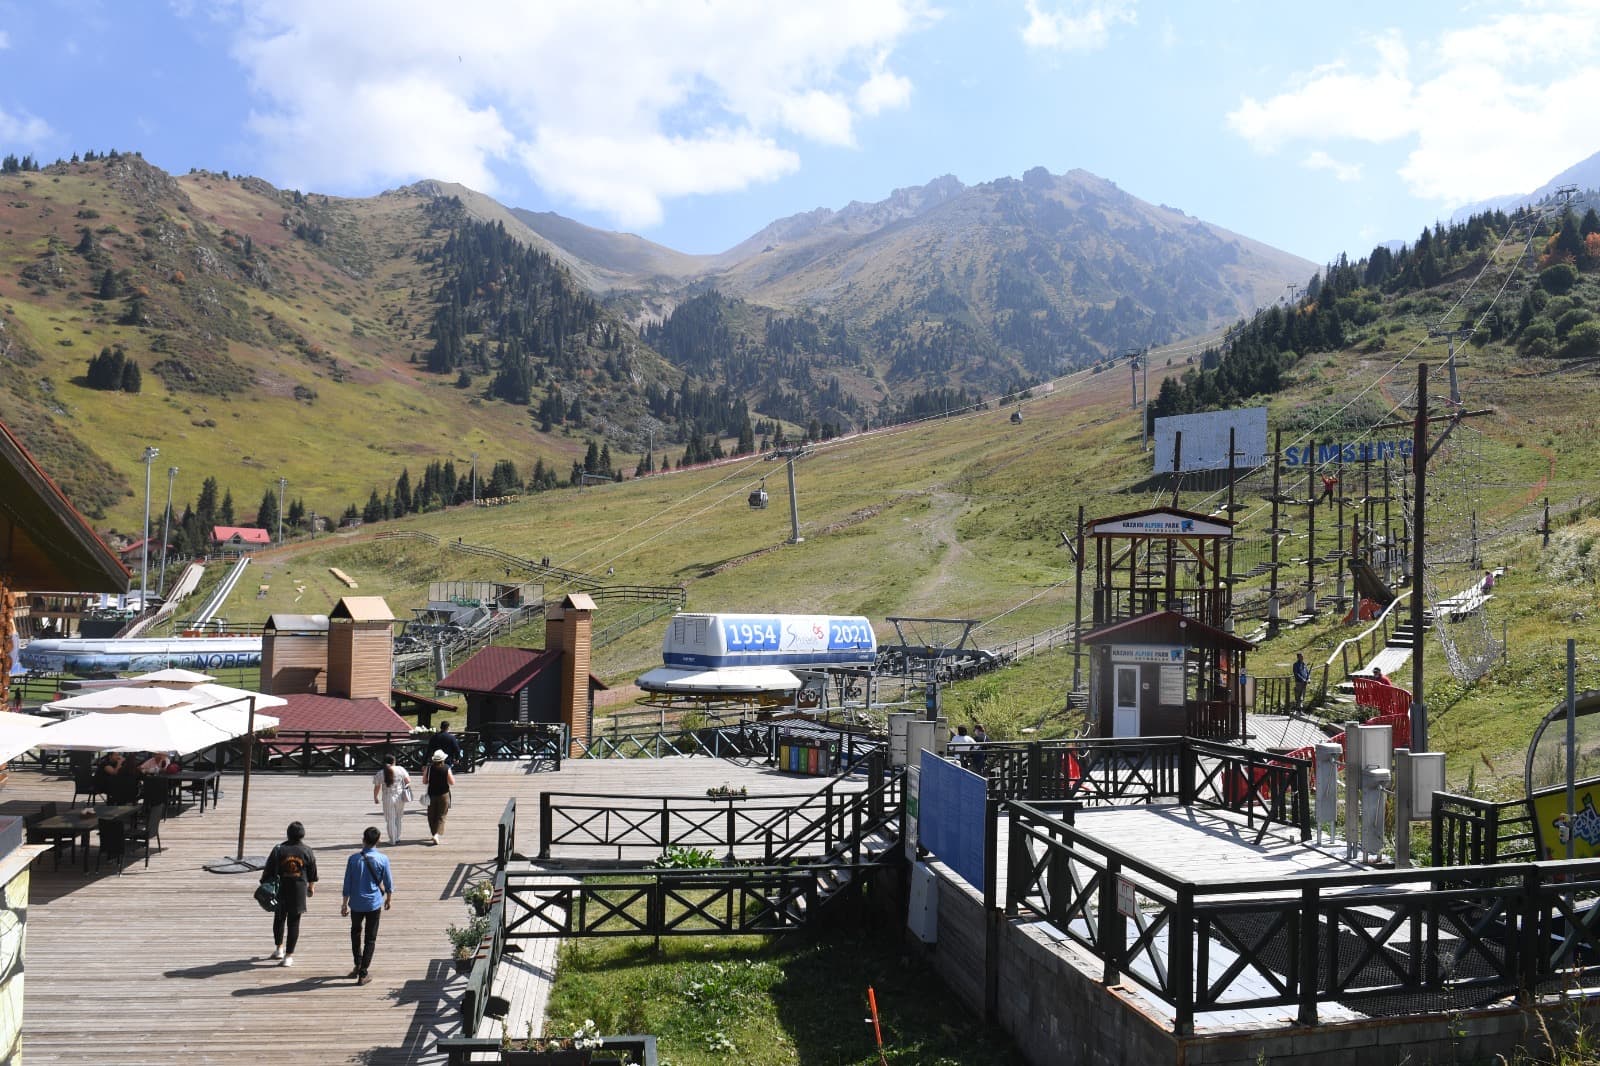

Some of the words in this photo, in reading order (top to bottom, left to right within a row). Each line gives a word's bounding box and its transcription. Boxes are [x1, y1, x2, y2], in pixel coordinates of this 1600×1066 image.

[1285, 439, 1414, 466] SAMSUNG
[729, 623, 777, 645] 1954
[831, 624, 870, 643] 2021
[195, 653, 252, 669] NOBEL
